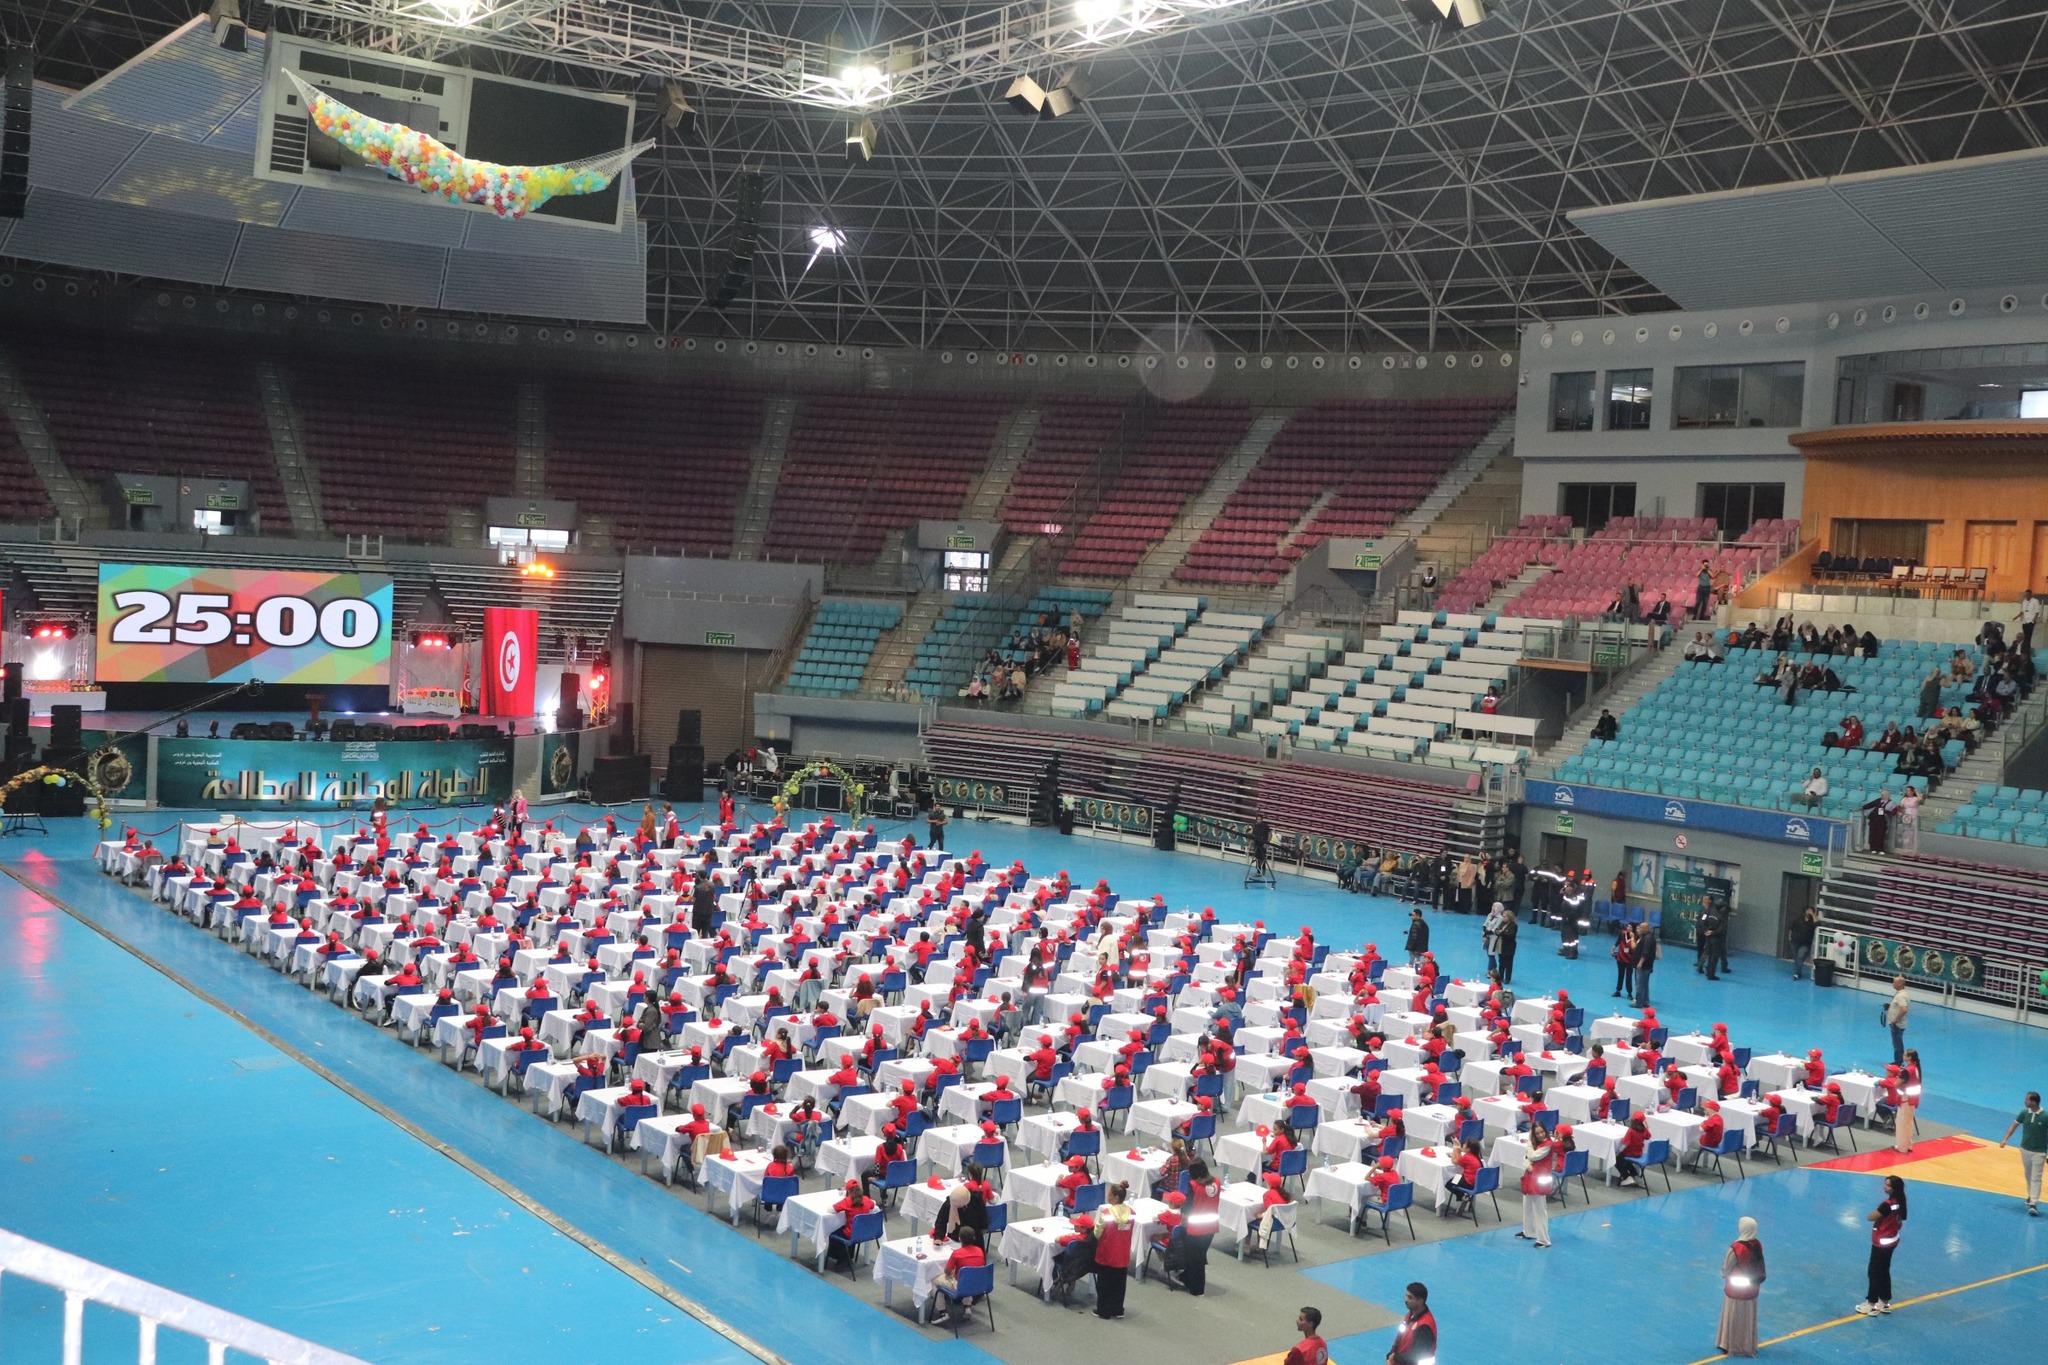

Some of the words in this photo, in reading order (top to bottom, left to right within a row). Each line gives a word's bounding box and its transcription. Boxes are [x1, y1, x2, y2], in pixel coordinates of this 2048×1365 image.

[207, 495, 215, 507] 5
[948, 536, 955, 548] 3
[1356, 554, 1363, 567] 2
[111, 590, 380, 648] 25:00
[202, 770, 317, 805] للمطالعة
[322, 769, 414, 808] الوطنية
[417, 767, 490, 804] البطولة
[1802, 864, 1821, 873] SORTIE
